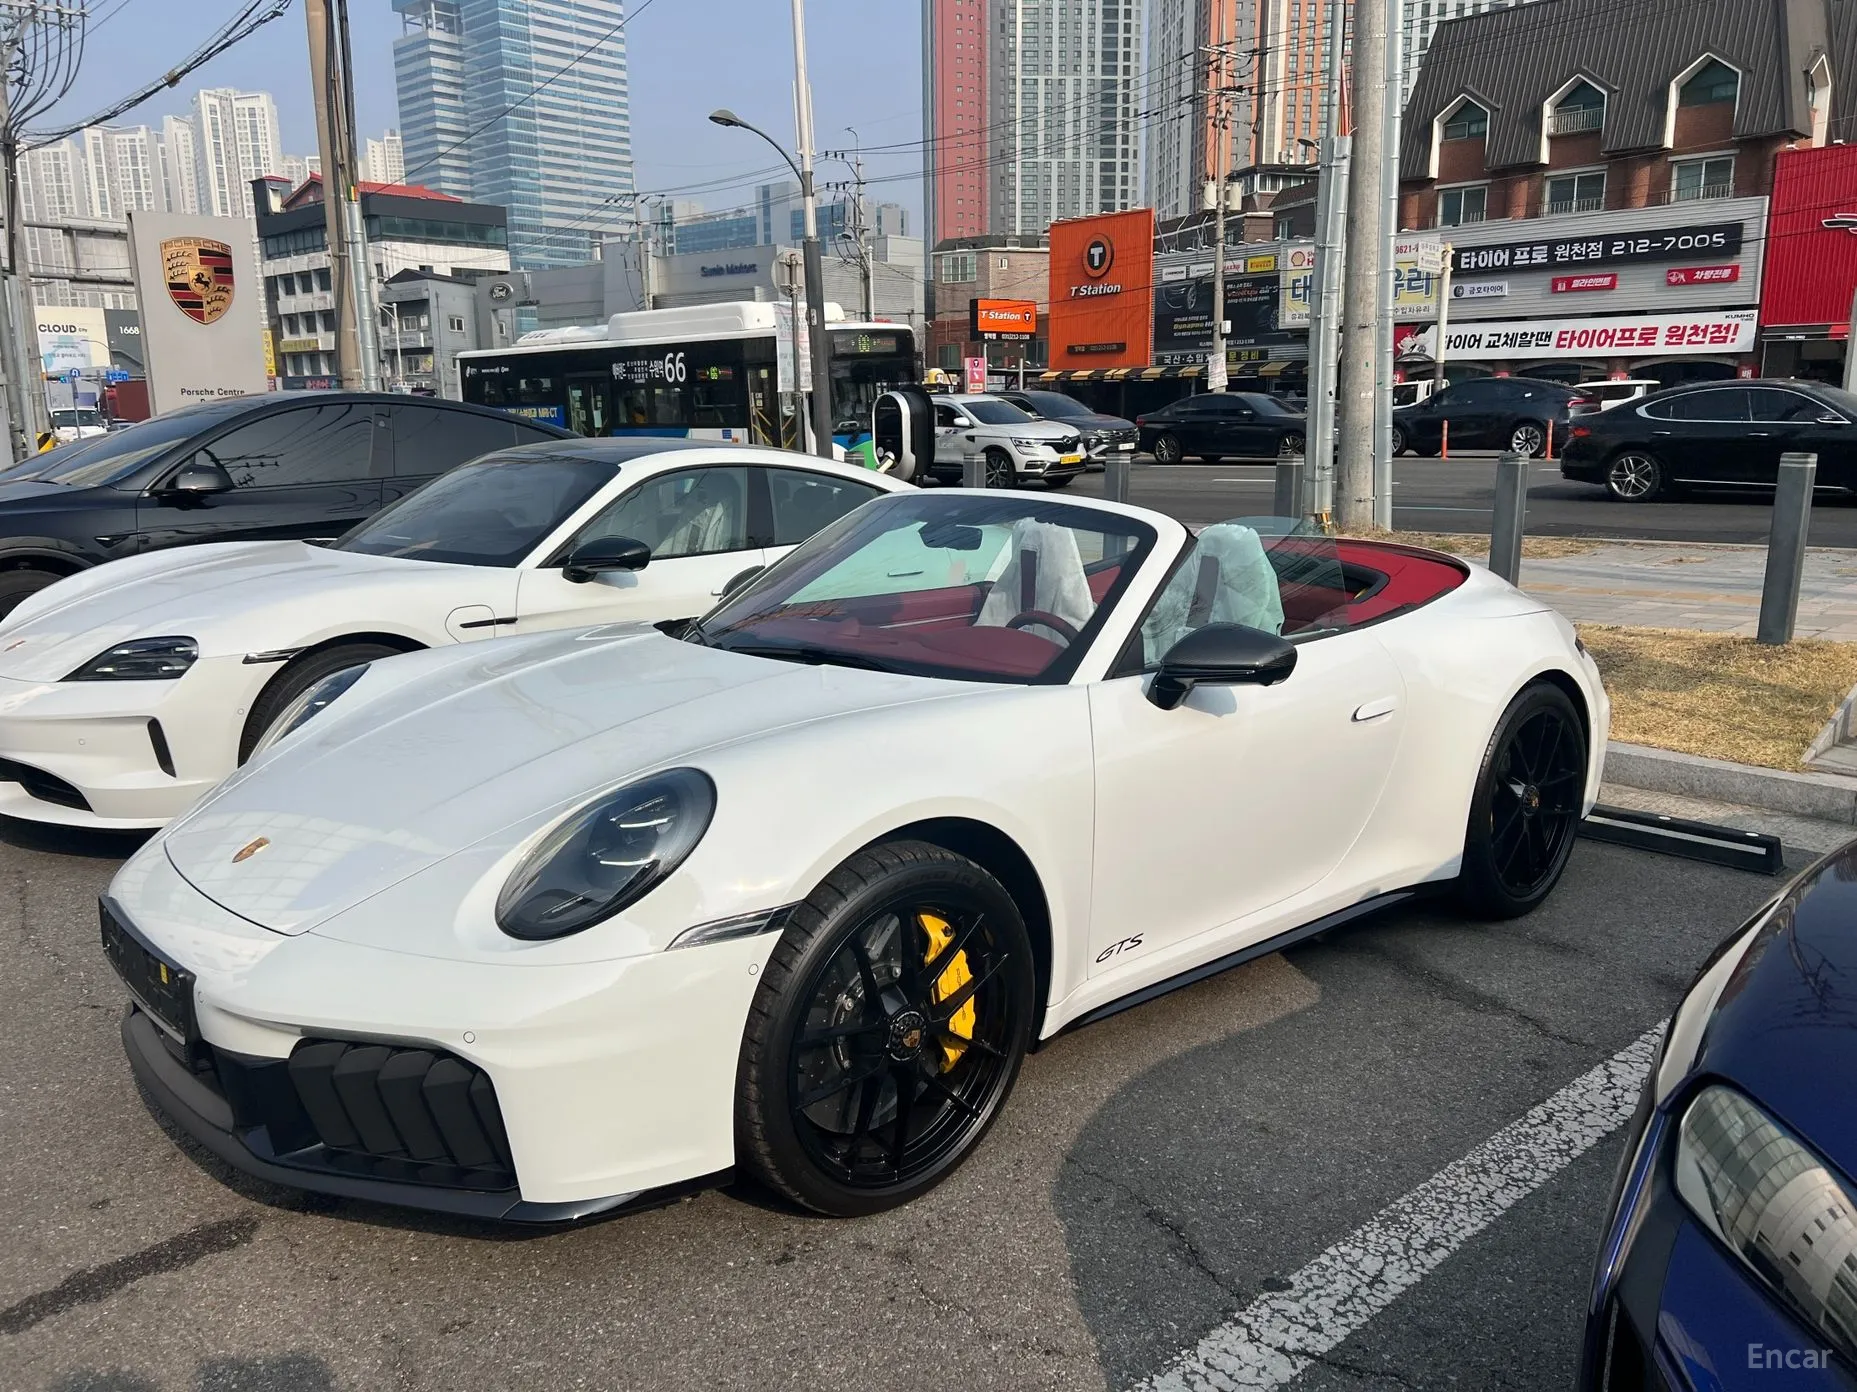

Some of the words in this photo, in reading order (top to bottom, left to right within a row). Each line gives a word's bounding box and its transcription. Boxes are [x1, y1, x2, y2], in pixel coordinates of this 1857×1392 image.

[1090, 247, 1103, 266] T
[1460, 248, 1510, 269] 타이어
[1513, 245, 1548, 266] 프로
[1554, 241, 1603, 262] 원천점
[1611, 233, 1726, 255] 212-7005
[1070, 286, 1079, 297] T
[1080, 283, 1121, 296] Station
[1468, 285, 1504, 295] 금호타이어
[981, 311, 988, 319] T
[988, 311, 1020, 320] Station
[38, 324, 77, 333] CLOUD
[119, 326, 140, 335] 1668
[1485, 331, 1552, 348] 교체할땐
[1555, 326, 1659, 350] 타이어프로
[1664, 323, 1740, 346] 원천점!
[664, 351, 686, 383] 66
[180, 388, 215, 396] Porsche
[217, 388, 245, 396] Centre
[1095, 932, 1144, 963] GTS
